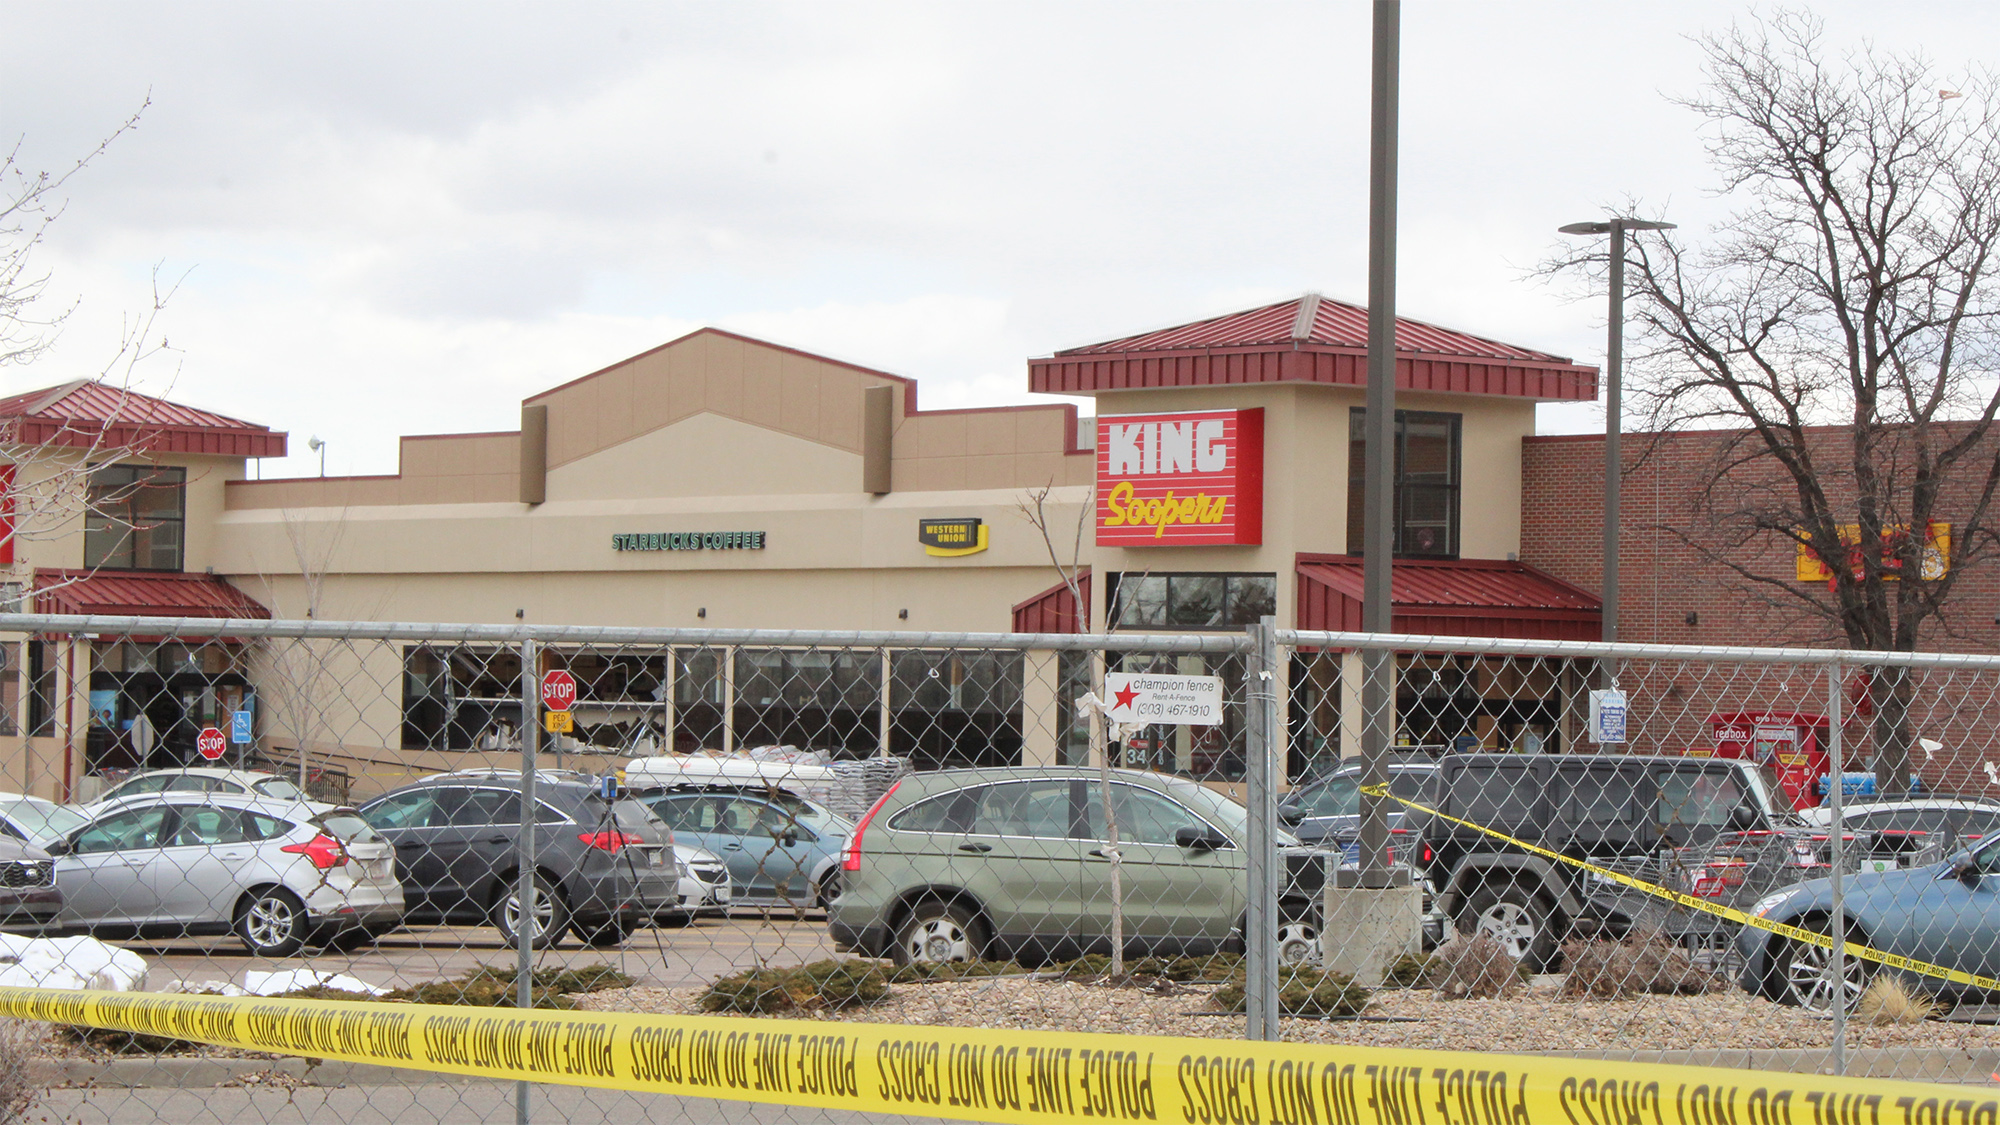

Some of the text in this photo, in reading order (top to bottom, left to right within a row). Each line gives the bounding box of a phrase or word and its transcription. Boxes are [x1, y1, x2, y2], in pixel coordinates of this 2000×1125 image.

[1108, 420, 1227, 475] KING
[1104, 481, 1227, 538] Soopers
[926, 525, 966, 534] WESTERN
[938, 534, 966, 542] UNION
[612, 531, 765, 550] STARBUCKS COFFEE
[544, 683, 573, 698] STOP
[1133, 678, 1214, 692] champion fence
[1152, 693, 1196, 702] Rent-A-Fence
[1136, 703, 1210, 717] (303) 467-1910
[1715, 728, 1747, 739] redbox
[1127, 749, 1146, 764] 34
[1645, 884, 1666, 897] POICE
[1682, 896, 1691, 904] DO
[1692, 898, 1704, 908] NOT
[1704, 903, 1726, 915] CROSS
[1801, 931, 1813, 942] NOT
[1887, 955, 1902, 966] LINE
[1913, 962, 1926, 972] NOT
[199, 1001, 242, 1043] POLICE
[247, 1004, 415, 1060] POLICE LINE DO NOT CROSS
[424, 1015, 617, 1078] POLICE LINE DO NOT CROSS
[630, 1025, 859, 1098] POLICE LINE DO NOT CROSS
[876, 1039, 1157, 1121] POLICE LINE DO NOT CROSS
[1177, 1054, 1531, 1125] POLICE LINE DO NOT CROSS
